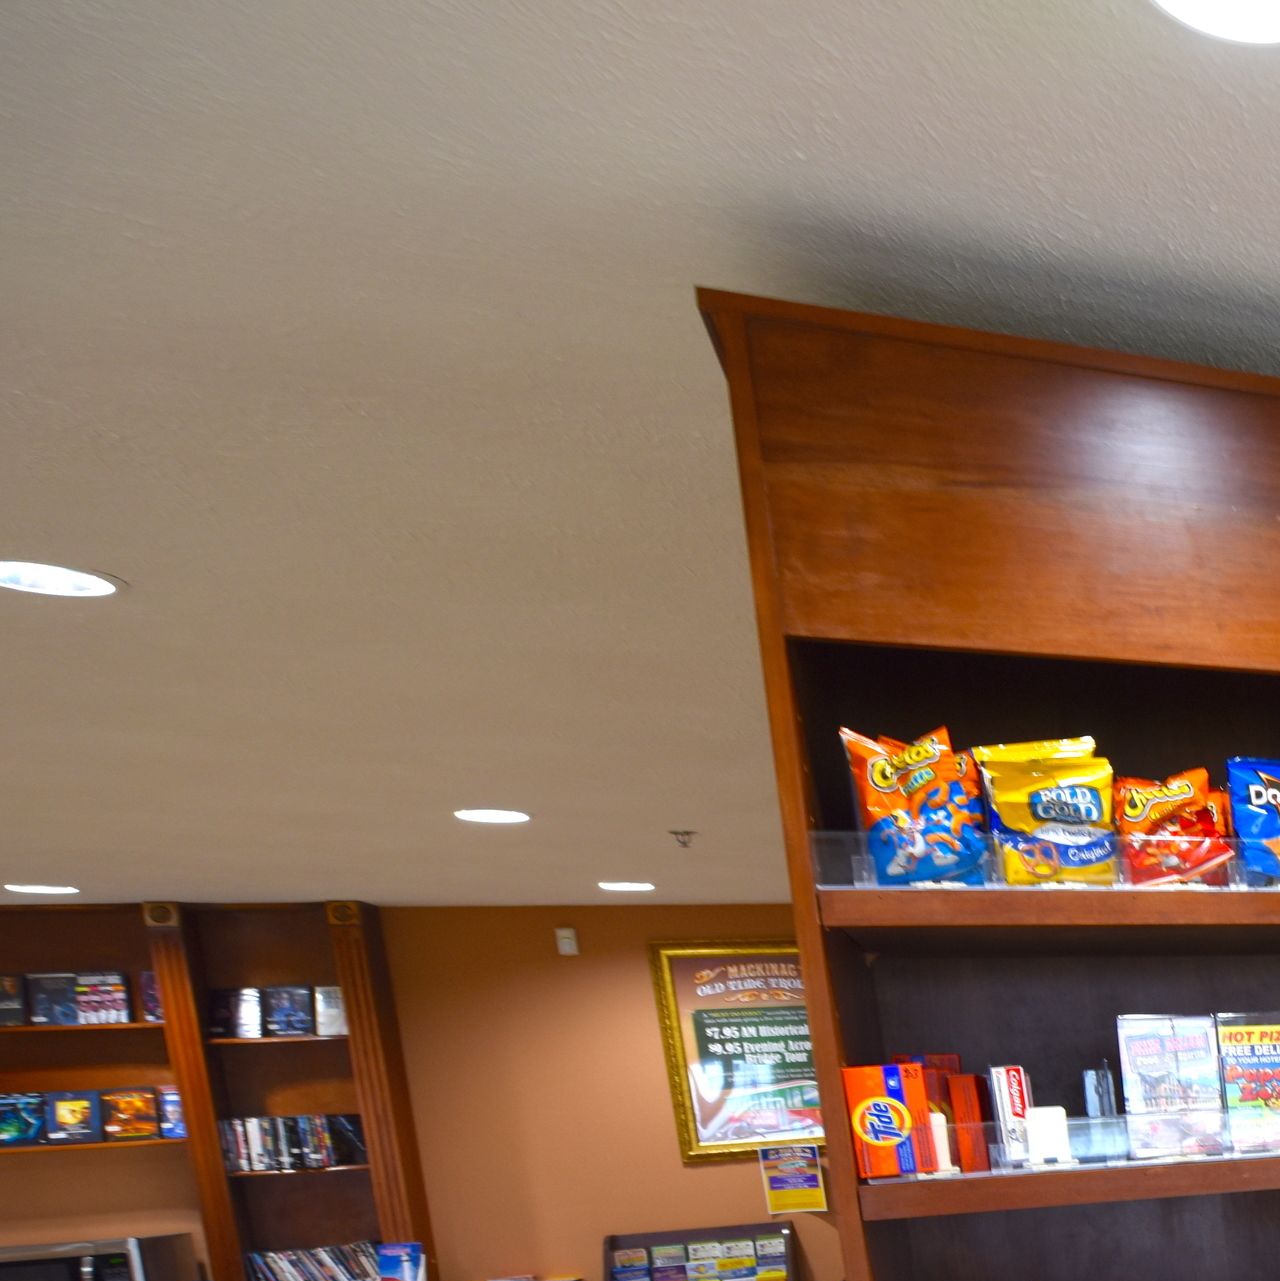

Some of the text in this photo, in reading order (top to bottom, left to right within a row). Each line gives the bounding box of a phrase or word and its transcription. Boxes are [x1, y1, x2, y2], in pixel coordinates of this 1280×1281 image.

[1036, 803, 1100, 822] GOLD
[1222, 1031, 1255, 1043] HOT
[1222, 1044, 1252, 1057] FREE
[1007, 1069, 1025, 1119] Colgate
[869, 1101, 905, 1142] Tide
